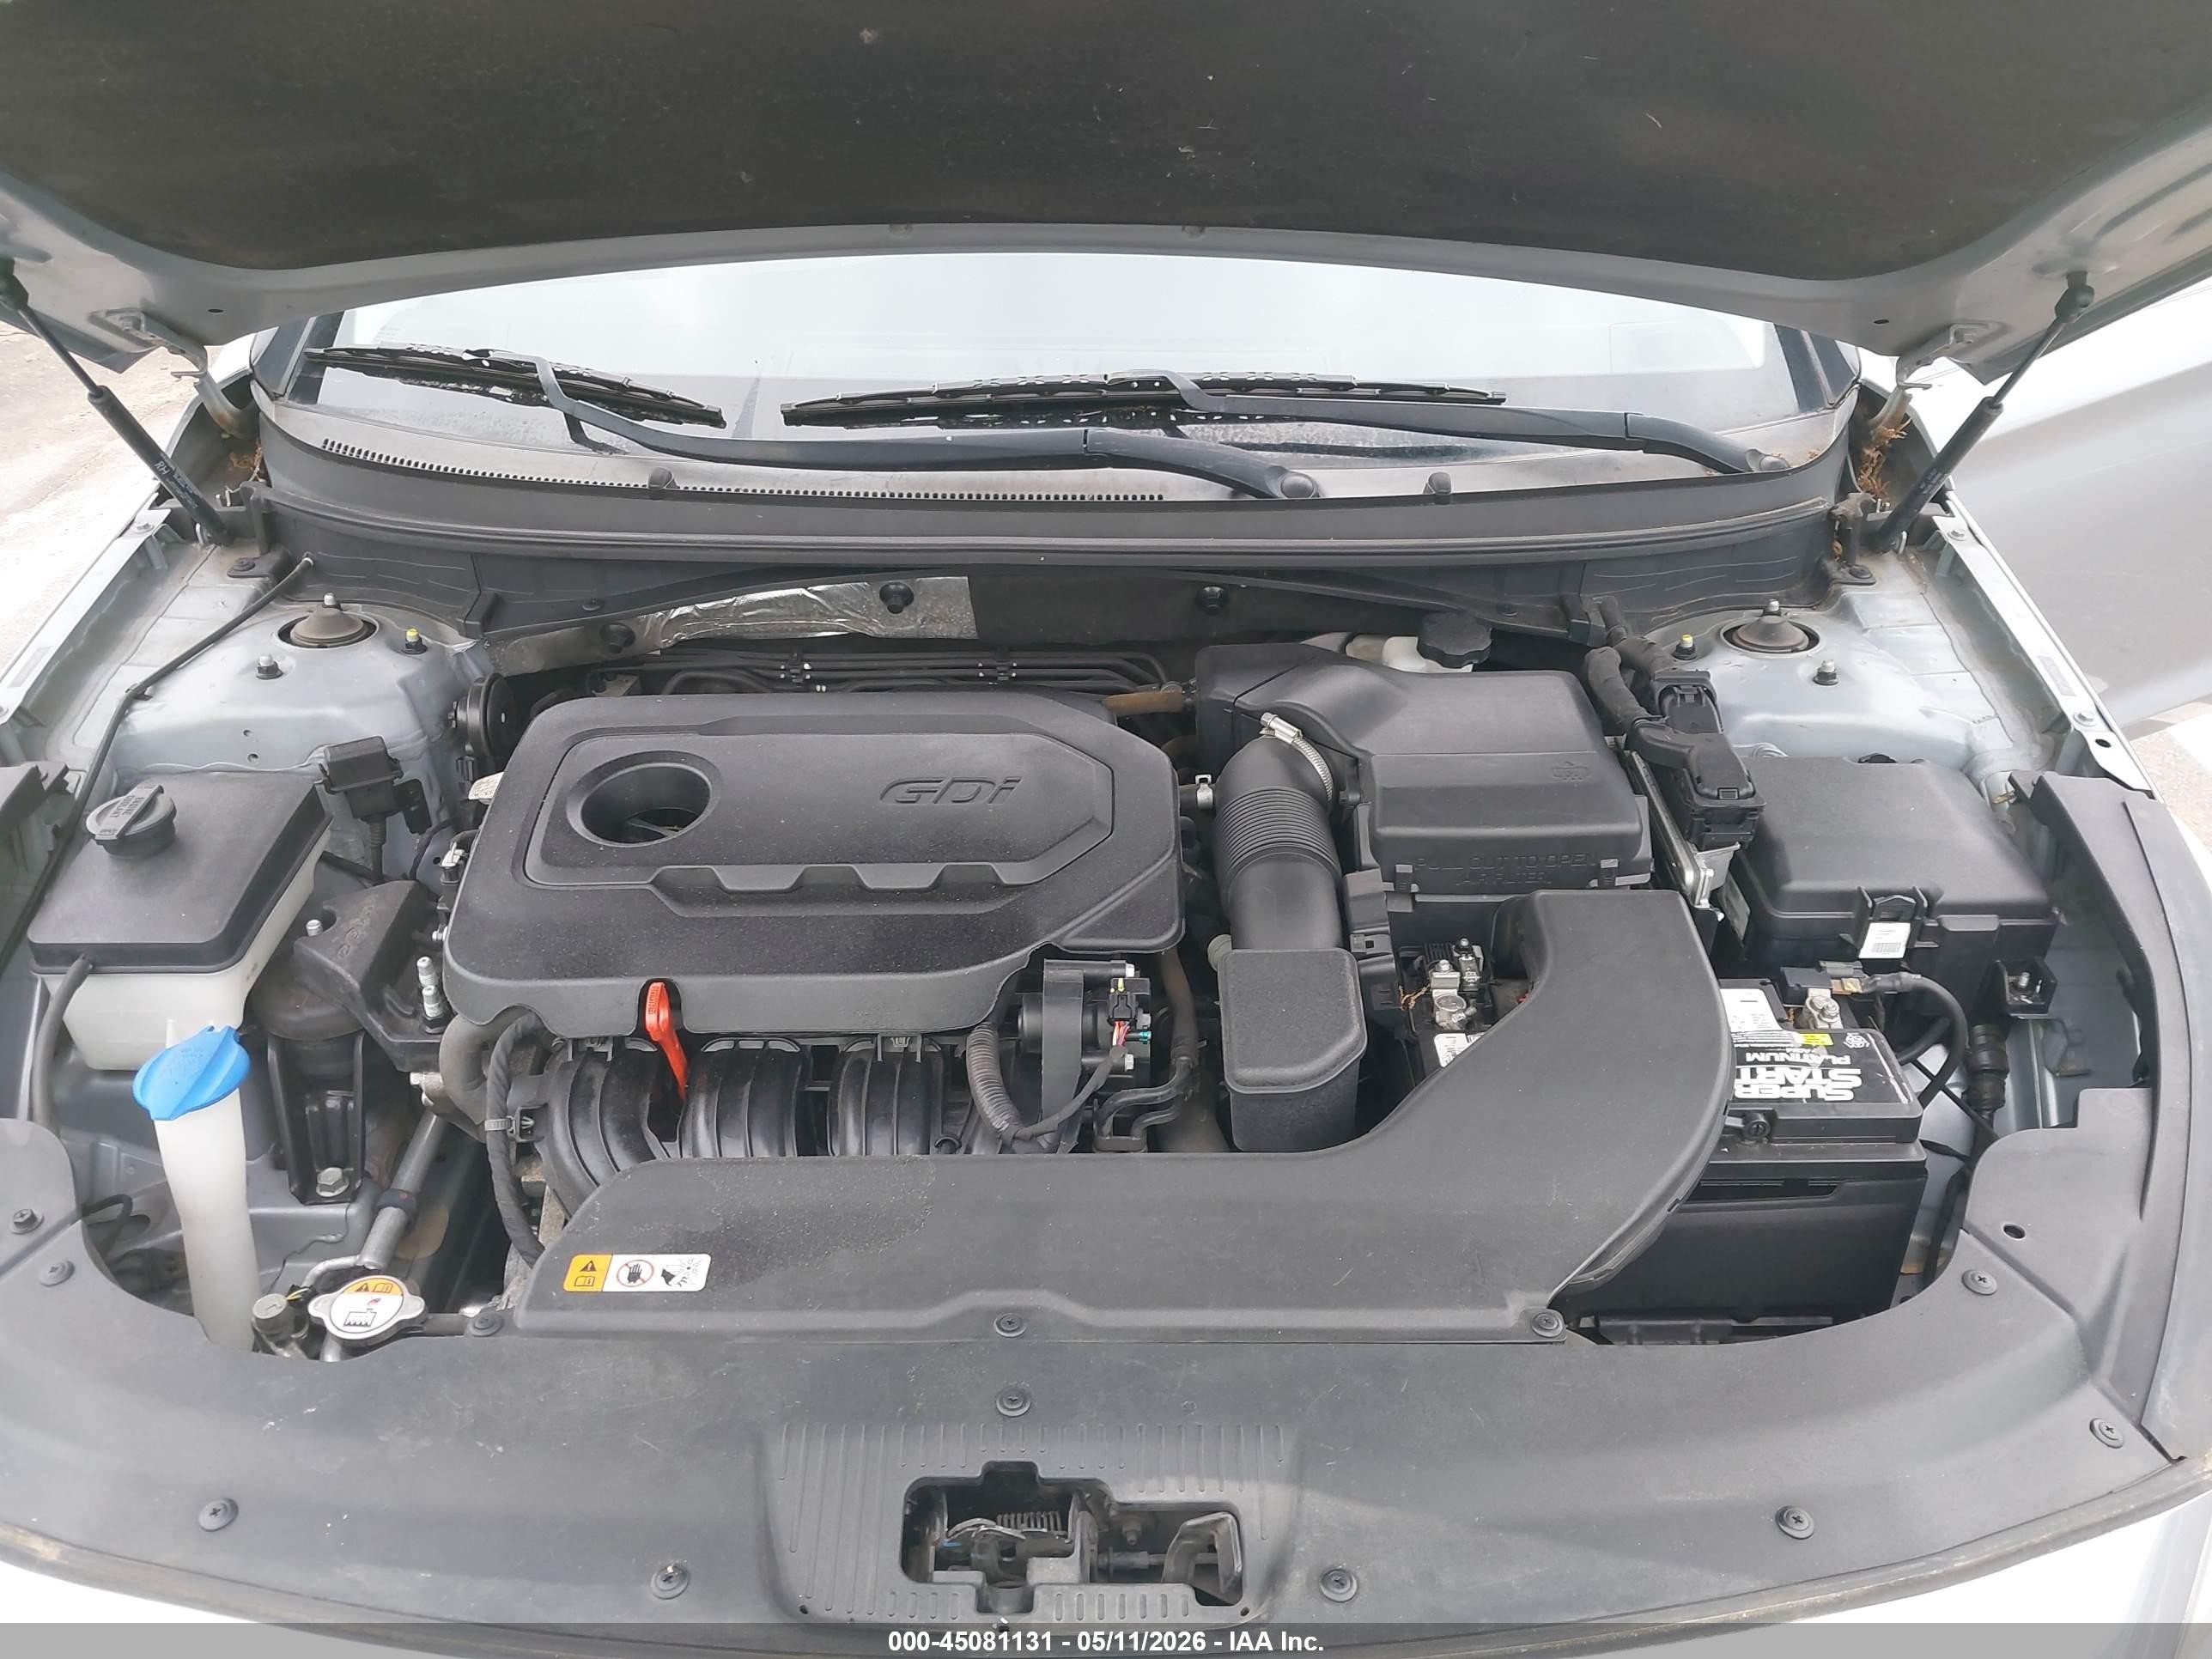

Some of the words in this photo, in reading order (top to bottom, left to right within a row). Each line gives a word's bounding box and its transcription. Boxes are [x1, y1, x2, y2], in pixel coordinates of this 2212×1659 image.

[155, 460, 171, 475] RH
[1735, 1067, 1863, 1088] START
[1735, 1084, 1854, 1101] SUPER
